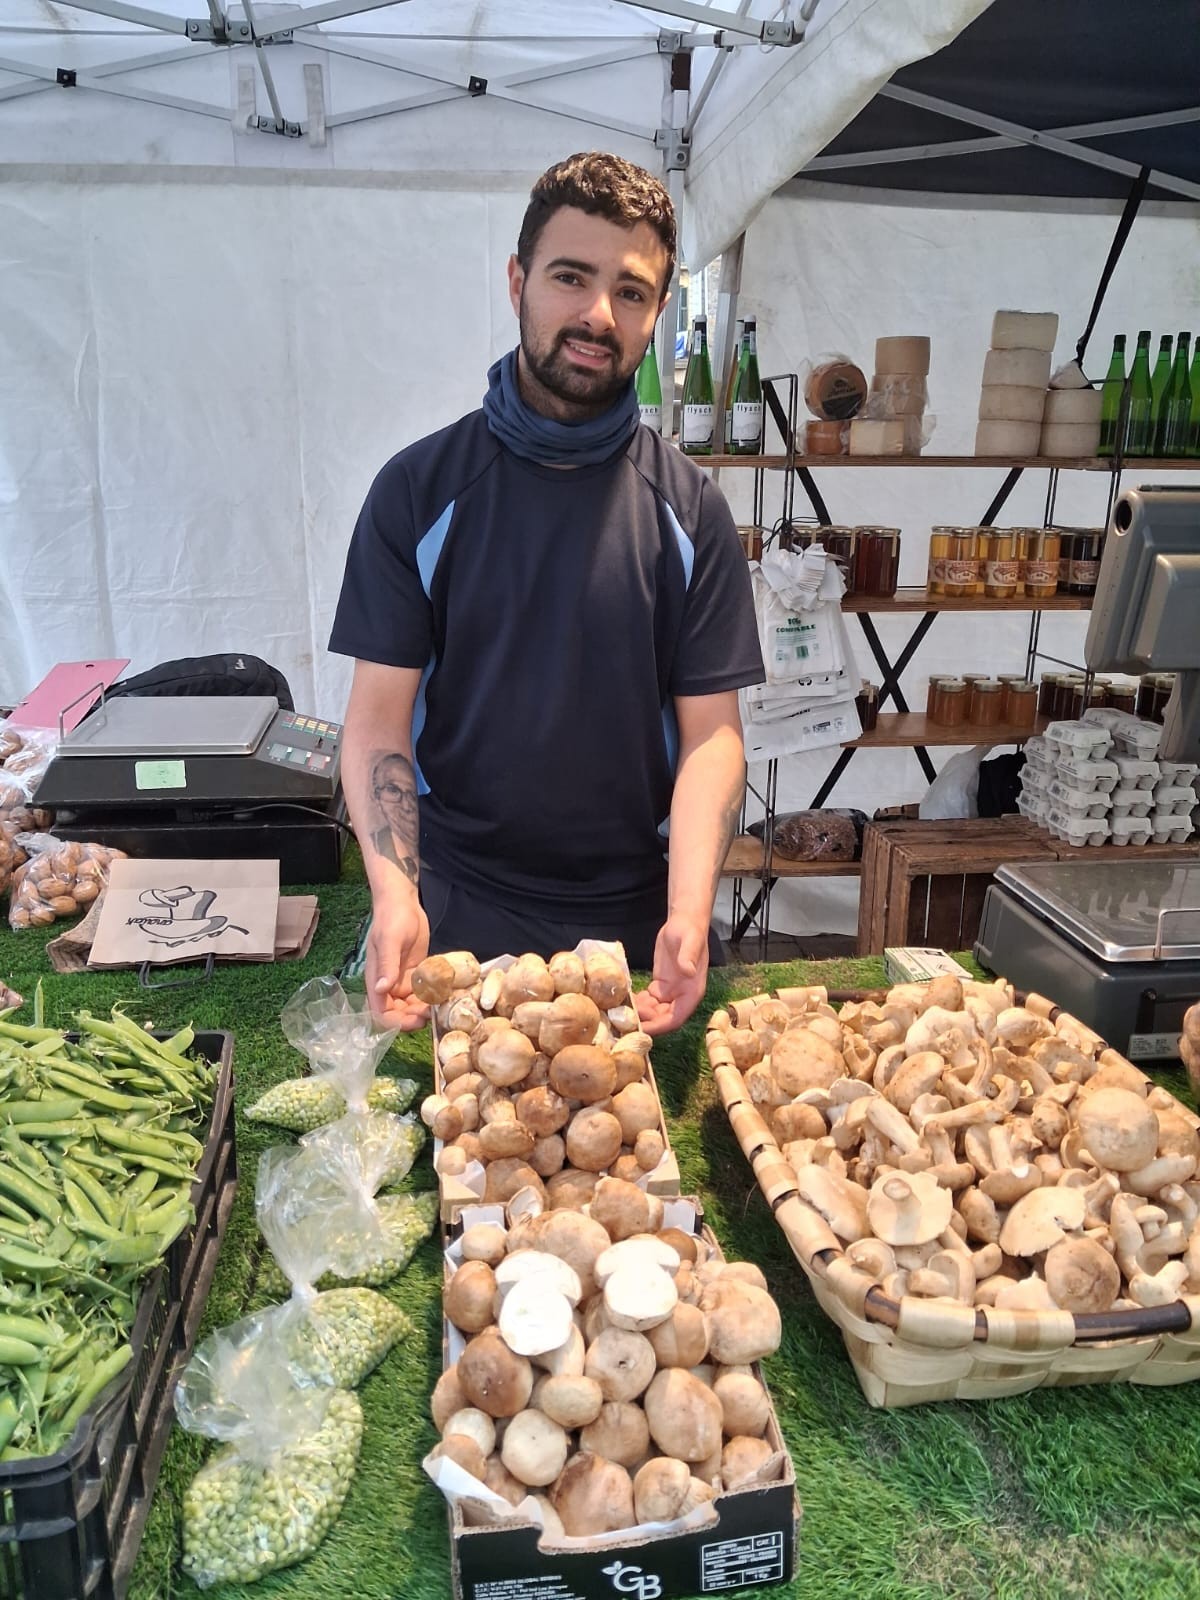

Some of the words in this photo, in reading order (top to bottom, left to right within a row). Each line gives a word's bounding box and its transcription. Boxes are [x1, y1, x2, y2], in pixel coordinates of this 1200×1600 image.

[687, 406, 712, 415] flysch
[737, 404, 761, 413] flysch
[612, 1565, 663, 1600] GB
